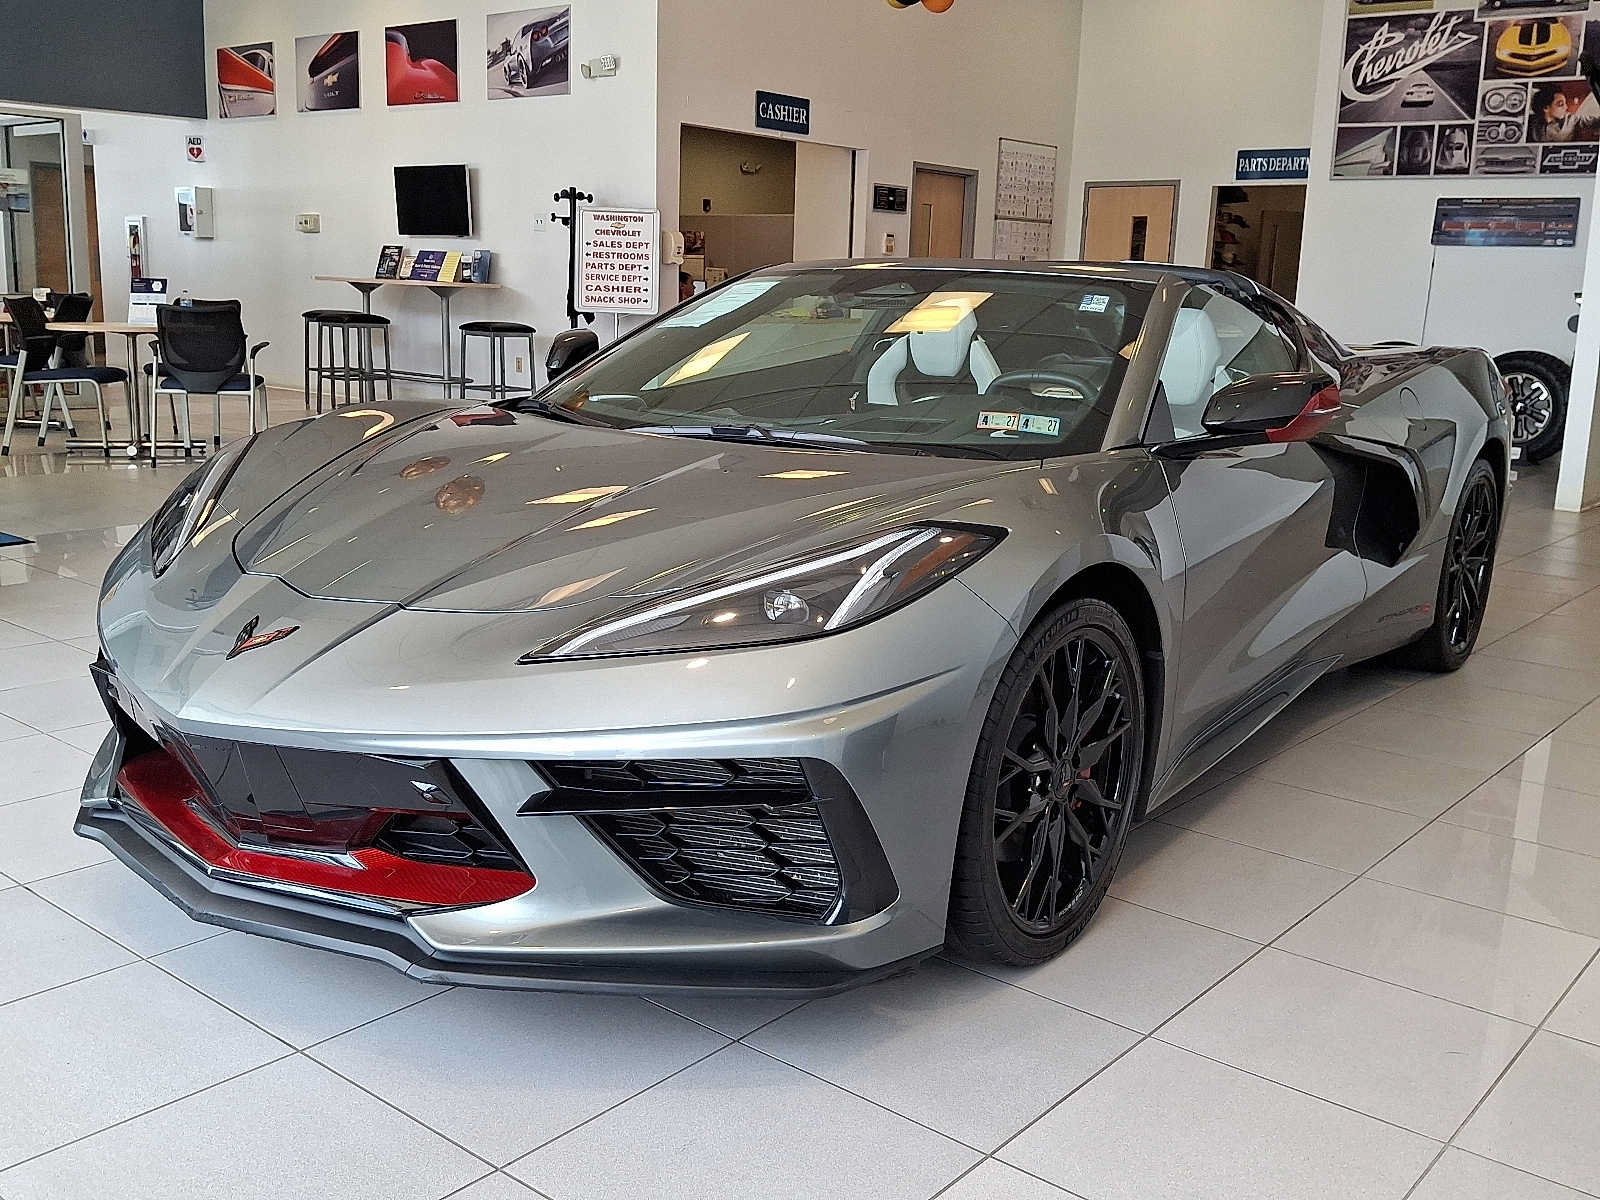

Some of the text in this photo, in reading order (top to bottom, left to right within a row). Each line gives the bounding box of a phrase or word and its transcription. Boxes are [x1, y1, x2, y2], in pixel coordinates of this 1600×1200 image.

[1341, 9, 1479, 102] Chevrolet
[759, 102, 807, 125] CASHIER
[1238, 157, 1268, 172] PARTS
[593, 214, 644, 223] WASHINGTON
[594, 229, 642, 237] CHEVROLET
[592, 240, 650, 250] SALES DEPT
[592, 251, 650, 261] RESTROOMS
[585, 262, 643, 272] PARTS DEPT
[584, 273, 642, 283] SERVICE DEPT
[585, 284, 642, 294] CASHIER
[584, 295, 642, 305] SNACK SHOP
[982, 415, 1017, 428] 4 27
[1022, 418, 1057, 432] 4 27
